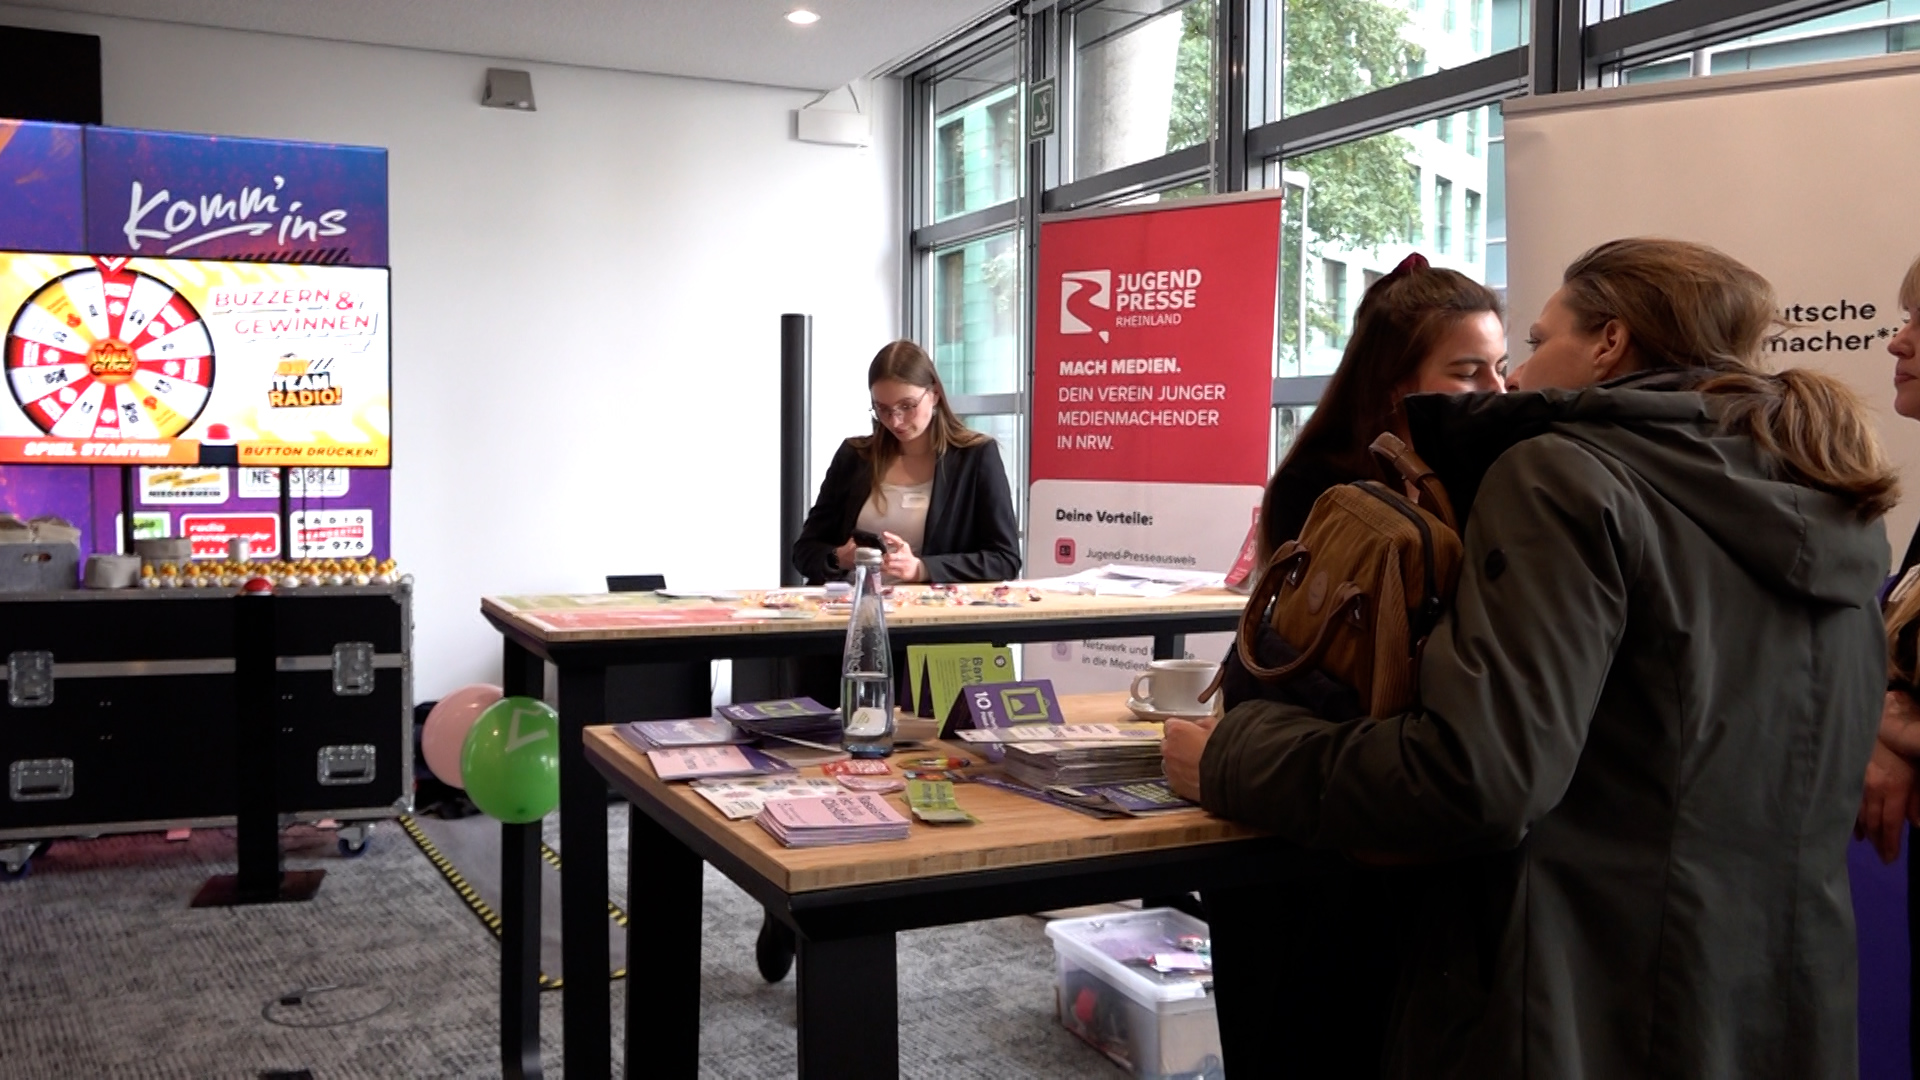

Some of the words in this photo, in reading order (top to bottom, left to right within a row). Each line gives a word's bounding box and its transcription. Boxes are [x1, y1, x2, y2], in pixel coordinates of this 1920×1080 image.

[278, 202, 347, 245] ins
[1116, 269, 1202, 292] JUGEND
[215, 289, 330, 306] BUZZERN
[335, 291, 354, 310] &
[1116, 289, 1196, 311] PRESSE
[235, 315, 370, 334] GEWINNEN
[1116, 313, 1182, 327] RHEINLAND
[1059, 360, 1107, 376] MACH
[1111, 357, 1182, 374] MEDIEN.
[271, 371, 331, 391] TEAM
[267, 384, 343, 408] RADIO!
[1058, 387, 1093, 402] DEIN
[1098, 385, 1153, 401] VEREIN
[1157, 383, 1226, 400] JUNGER
[1057, 408, 1220, 426] MEDIENMACHENDER
[243, 446, 303, 457] BUTTON
[1057, 435, 1072, 449] IN
[1076, 434, 1114, 450] NRW.
[1056, 509, 1093, 522] Deine
[1096, 510, 1153, 526] Vorteile:
[1086, 548, 1197, 566] Jugend-Presseausweis
[1082, 639, 1127, 653] Netzwerk
[1129, 645, 1148, 656] und
[1093, 656, 1107, 667] die
[974, 691, 992, 713] 10
